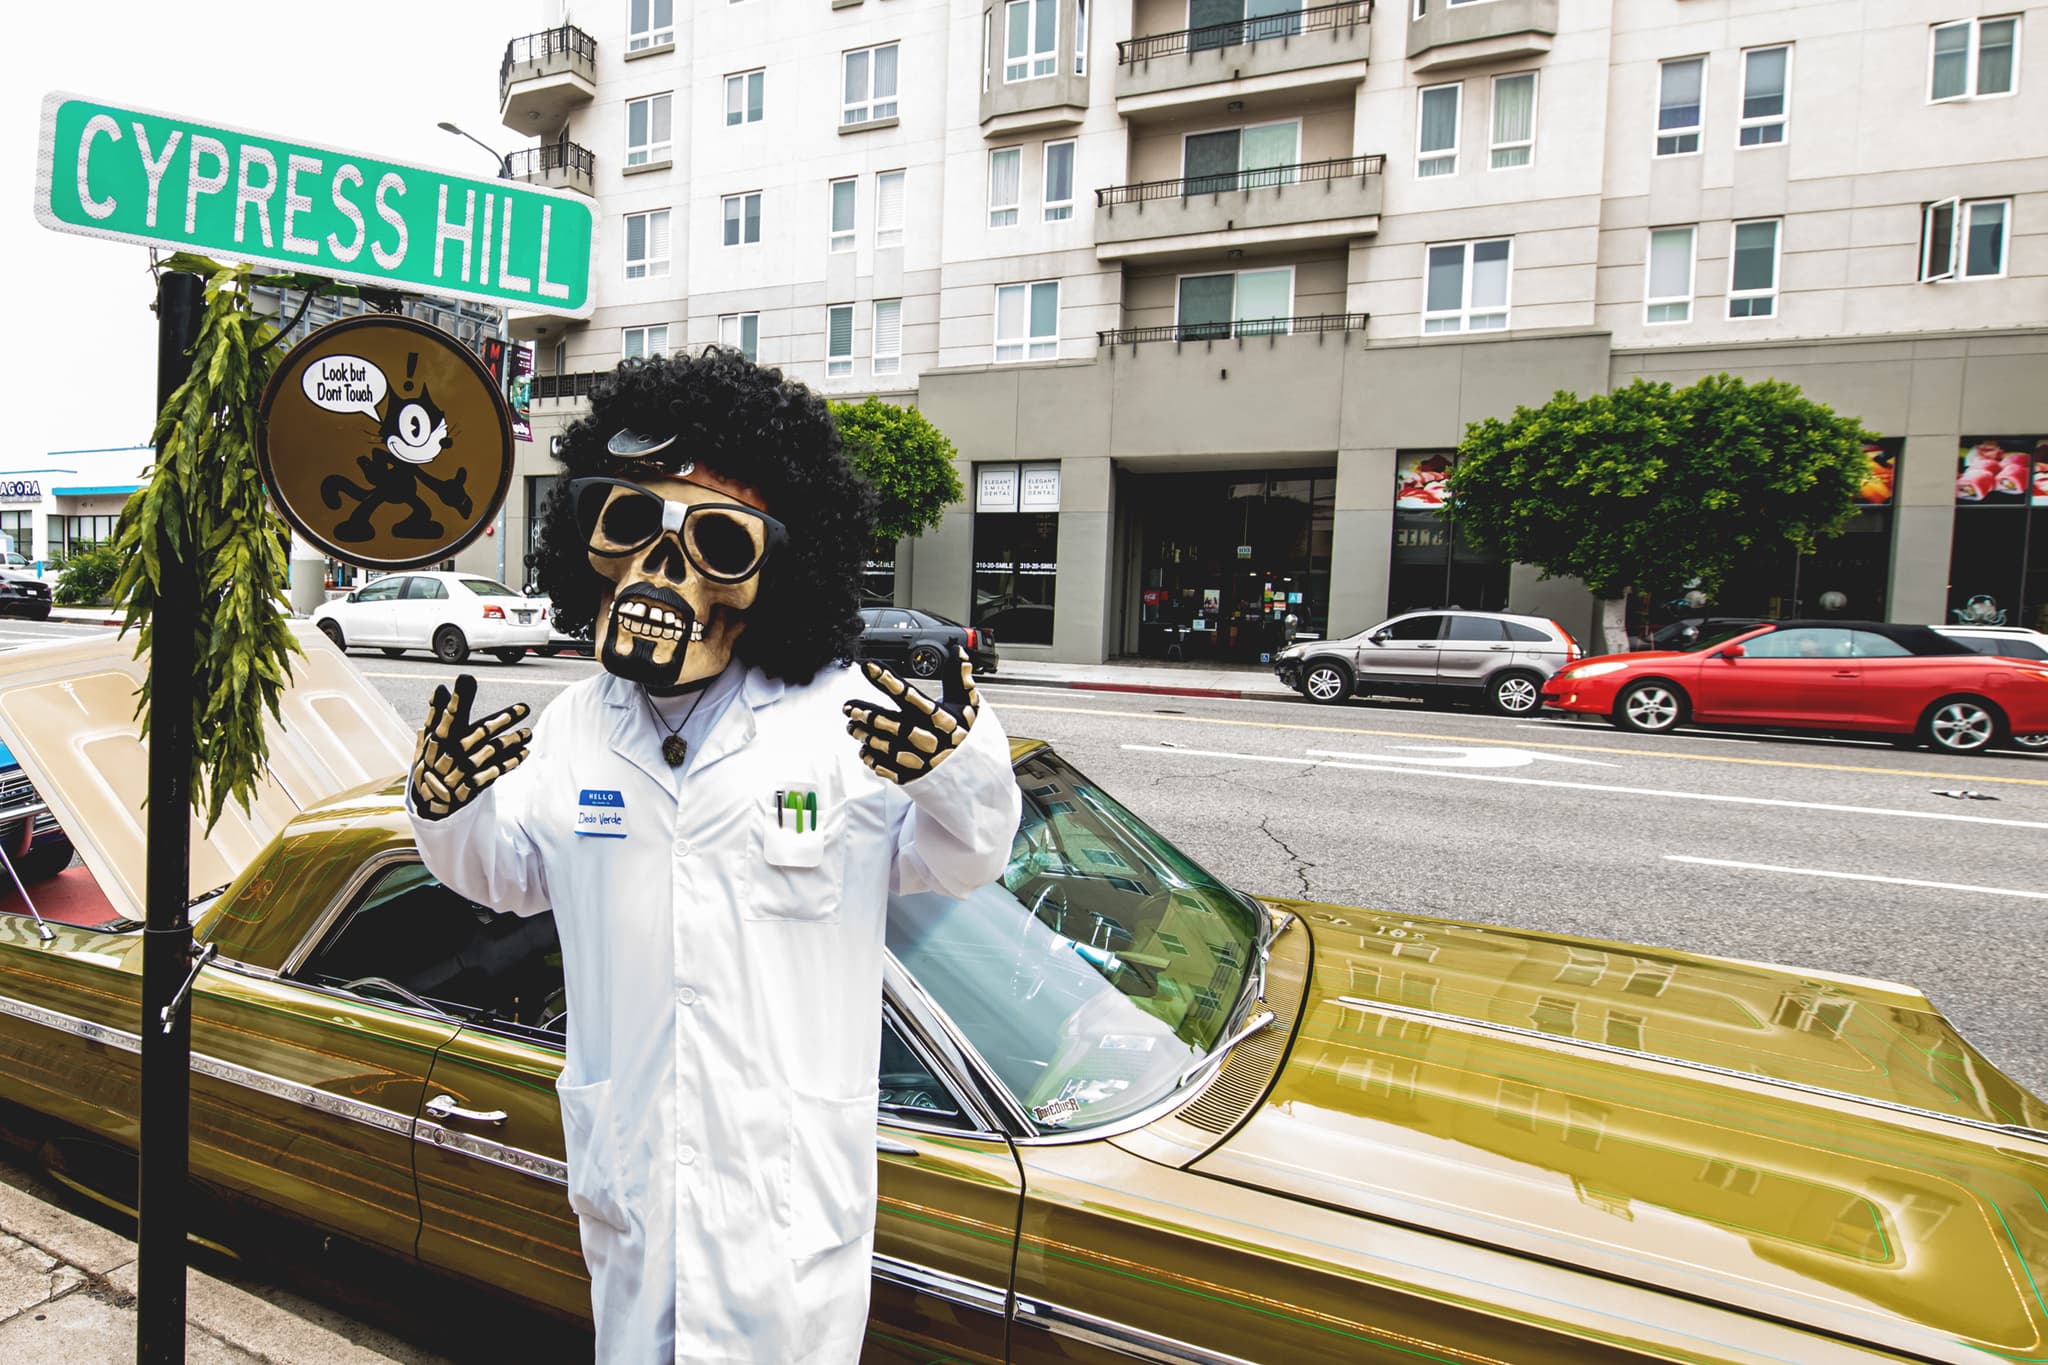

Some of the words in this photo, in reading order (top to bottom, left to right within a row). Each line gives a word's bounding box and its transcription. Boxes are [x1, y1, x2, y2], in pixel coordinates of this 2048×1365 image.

[76, 114, 408, 270] CYPRESS
[433, 184, 570, 300] HILL
[322, 362, 349, 382] Look
[350, 362, 366, 382] but
[317, 382, 342, 401] Dont
[344, 383, 373, 402] Touch
[0, 480, 41, 496] AGORA
[589, 793, 613, 801] HELLO
[599, 812, 622, 825] Verde
